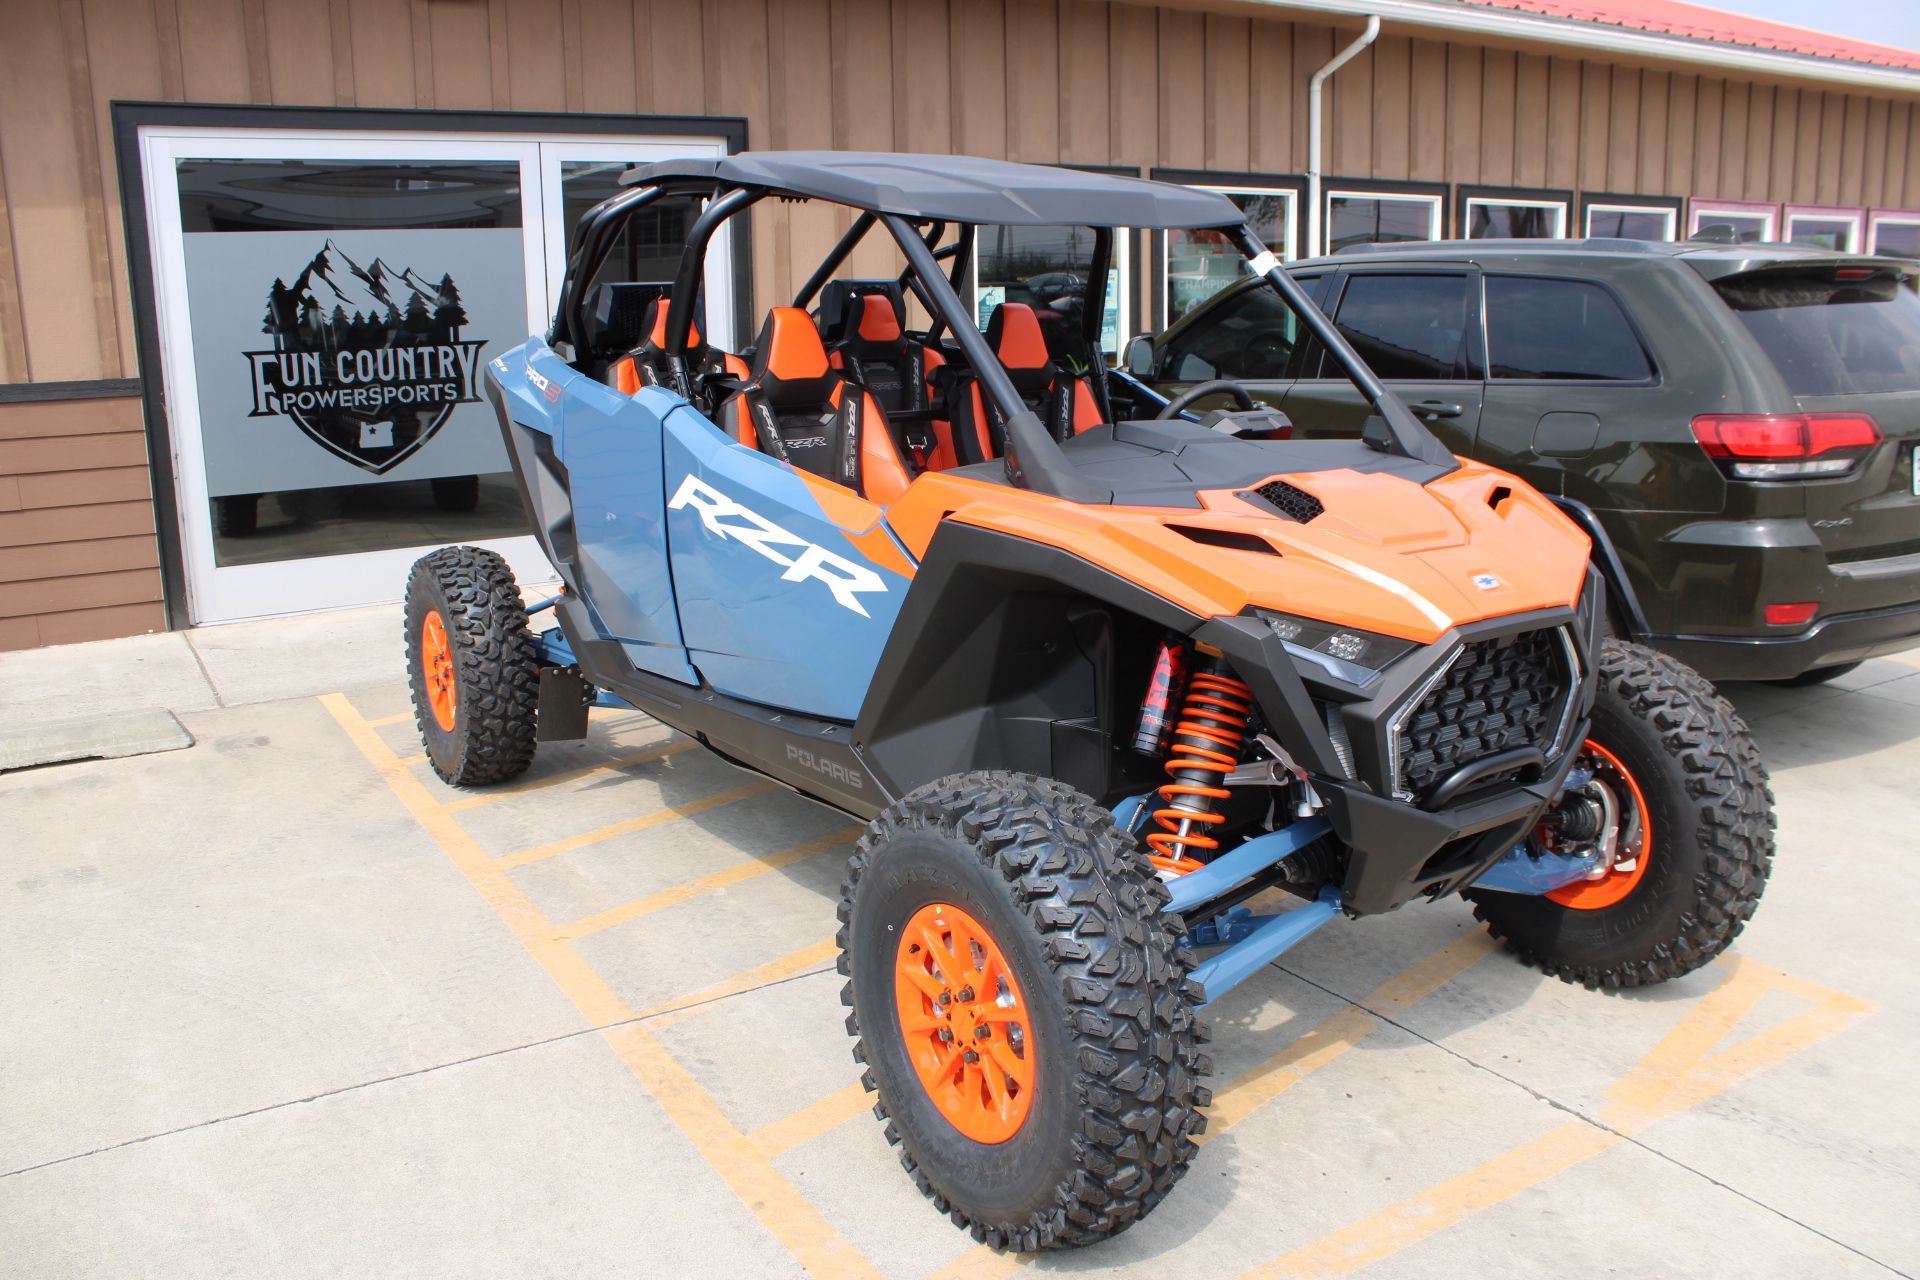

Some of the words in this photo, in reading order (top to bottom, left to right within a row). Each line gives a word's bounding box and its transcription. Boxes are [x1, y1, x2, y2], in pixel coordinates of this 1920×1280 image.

[1178, 279, 1236, 289] CHAMPION
[251, 352, 323, 413] FUN
[337, 344, 479, 400] COUNTRY
[527, 364, 549, 392] PRO
[282, 382, 458, 412] POWERSPORTS
[758, 404, 778, 440] RZR
[848, 399, 856, 437] RZR
[785, 436, 828, 449] RZR
[667, 473, 889, 619] RZR
[786, 743, 863, 789] POLARIS
